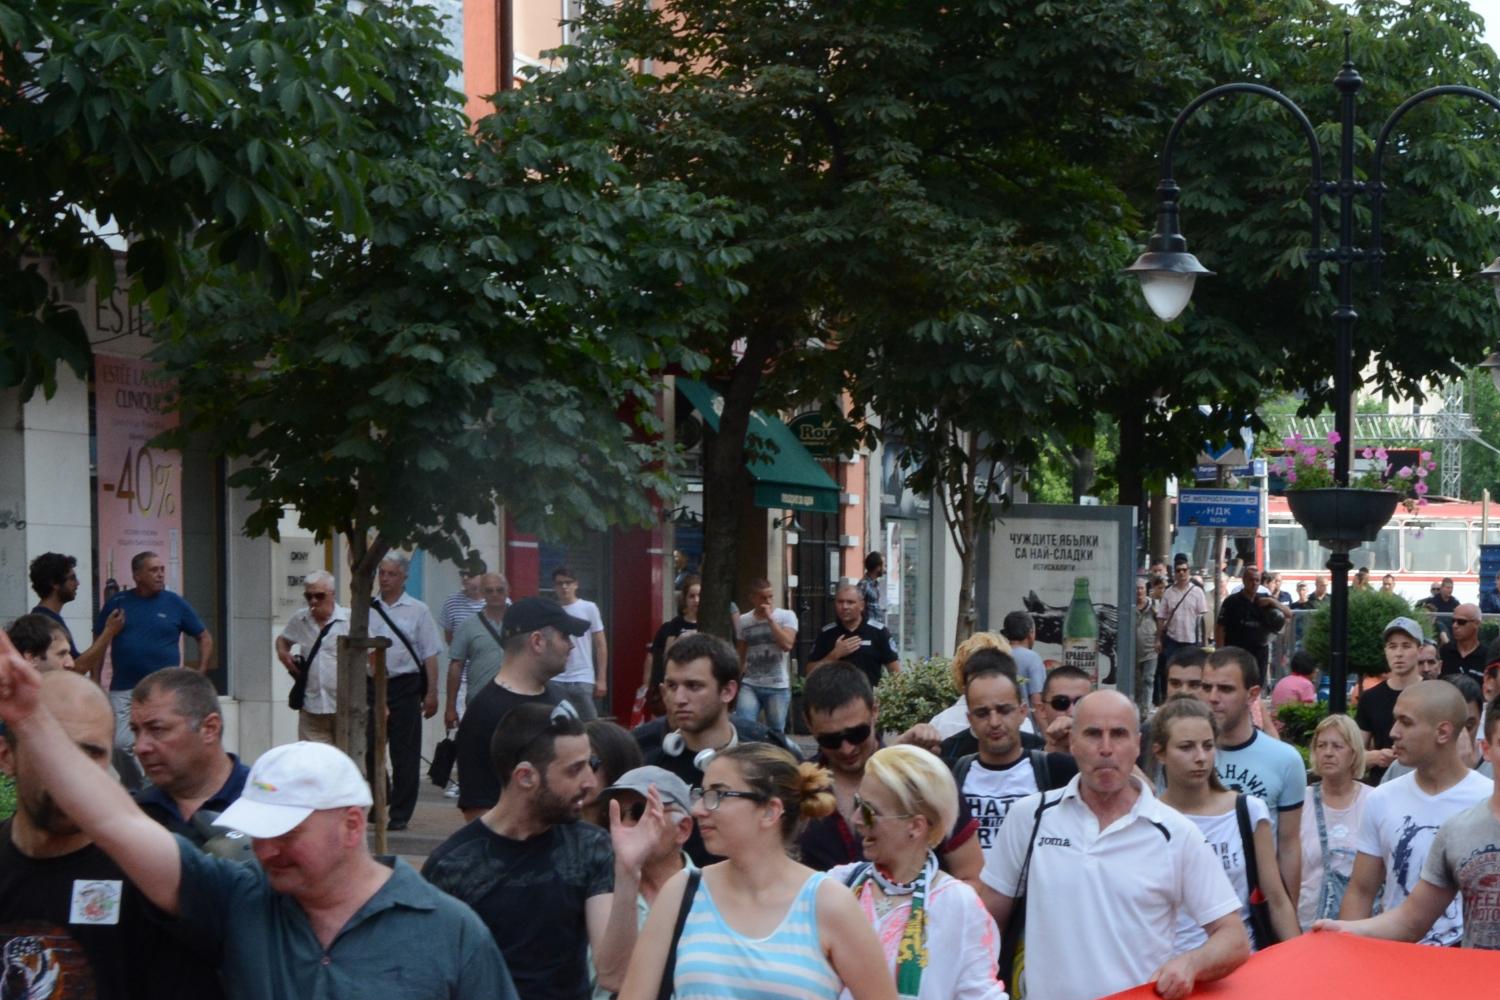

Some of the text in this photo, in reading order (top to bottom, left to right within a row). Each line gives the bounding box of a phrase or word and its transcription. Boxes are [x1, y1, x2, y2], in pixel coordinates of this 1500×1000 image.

[103, 446, 175, 518] -40%
[1207, 506, 1231, 516] НДК
[1010, 533, 1099, 546] ЧУЖДИТЕ ЯБЪЛКИ
[1015, 546, 1093, 561] СА НАЙ-СЛАДКИ
